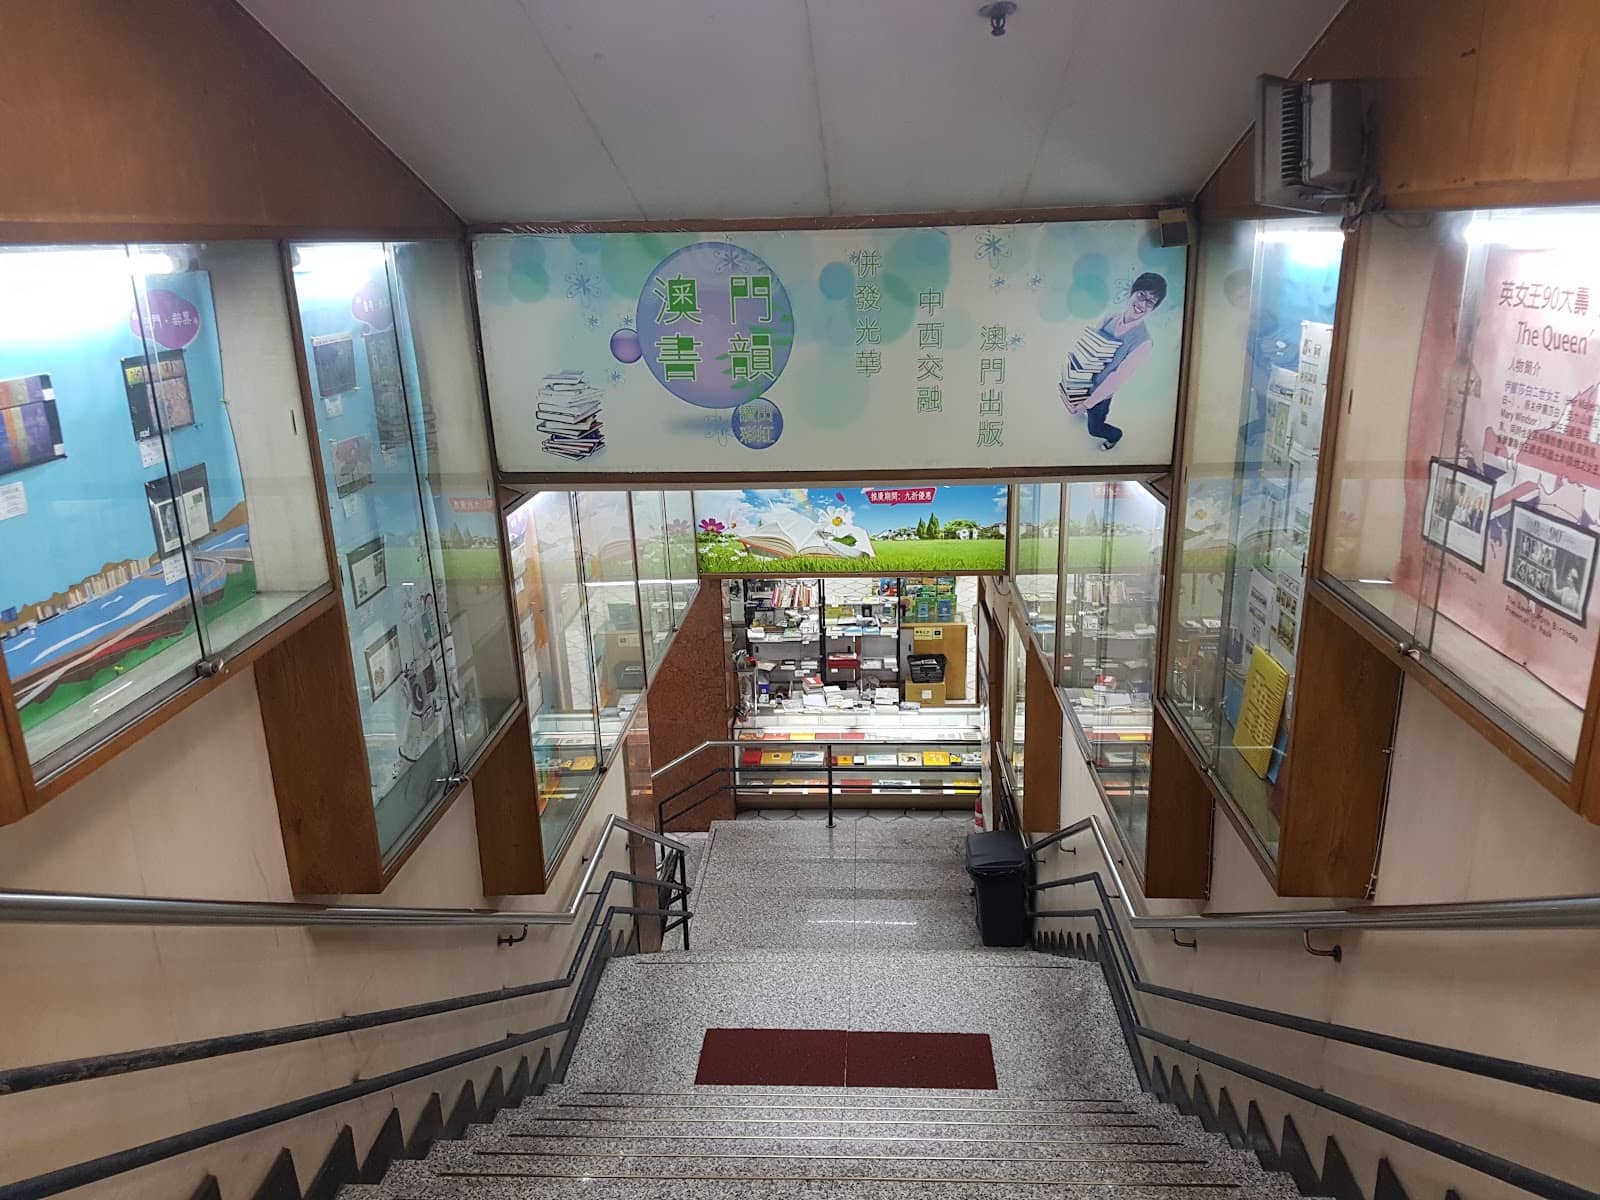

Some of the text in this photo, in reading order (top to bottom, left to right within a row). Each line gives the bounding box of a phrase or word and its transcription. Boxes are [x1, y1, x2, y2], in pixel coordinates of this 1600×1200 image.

[653, 272, 772, 325] 澳門
[1498, 280, 1591, 317] 英女王90大壽
[654, 332, 776, 382] 書韻
[917, 287, 944, 414] 中西交融
[1516, 320, 1541, 347] The
[977, 325, 1006, 448] 澳門出版
